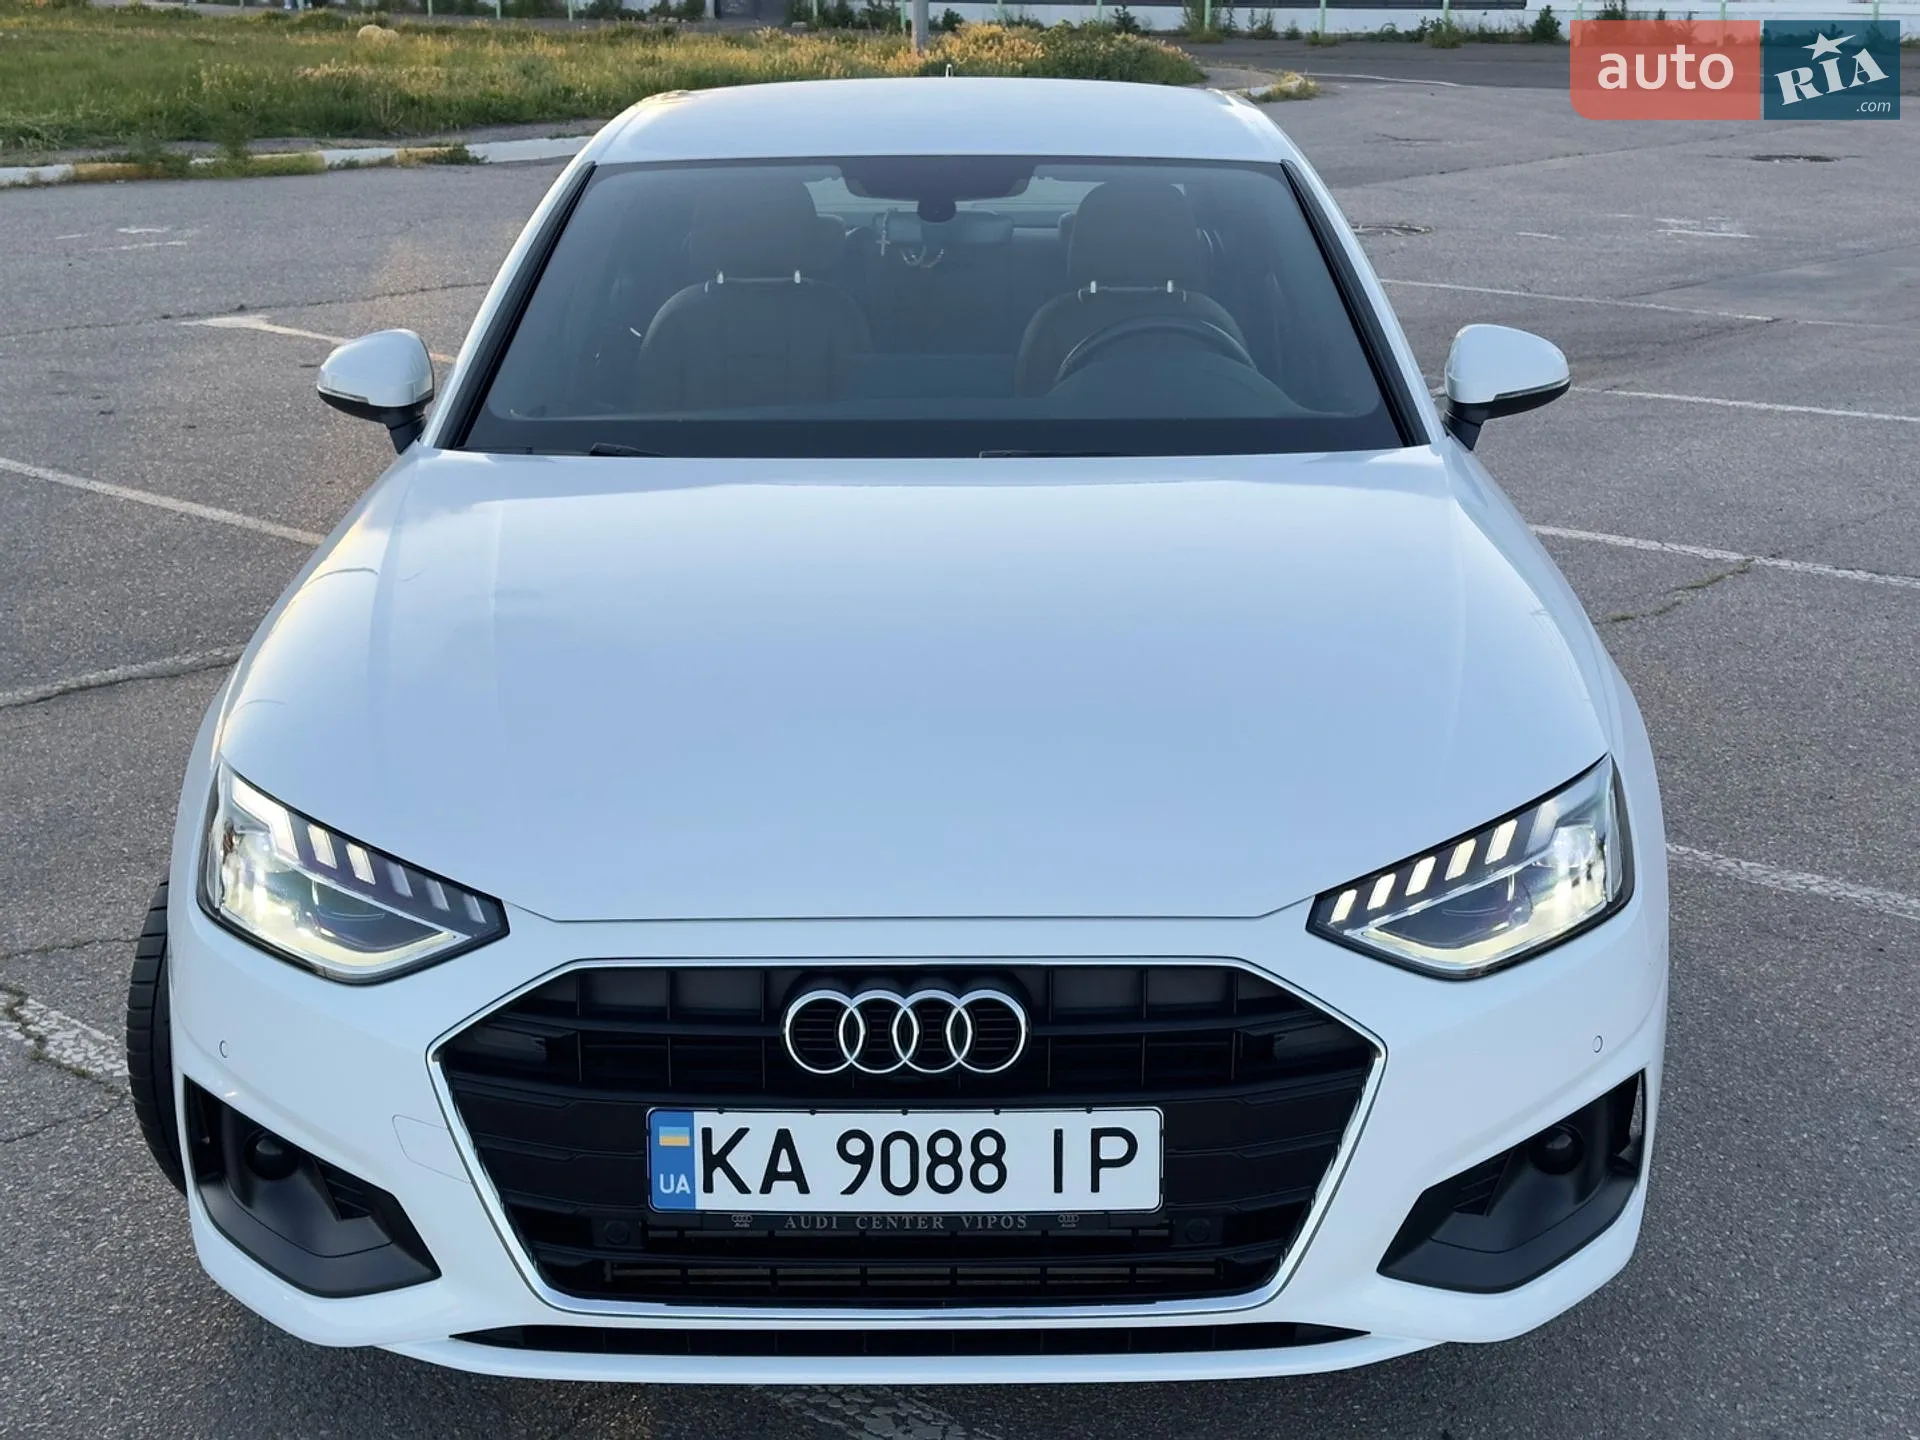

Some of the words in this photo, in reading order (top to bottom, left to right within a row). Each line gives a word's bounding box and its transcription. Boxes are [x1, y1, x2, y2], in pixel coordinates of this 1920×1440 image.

[701, 1127, 810, 1194] KA
[836, 1128, 1007, 1196] 9088
[1053, 1127, 1139, 1194] IP
[659, 1173, 691, 1194] UA
[784, 1216, 838, 1229] AUDI
[856, 1215, 945, 1229] CENTER
[961, 1215, 1028, 1229] VIPOS
